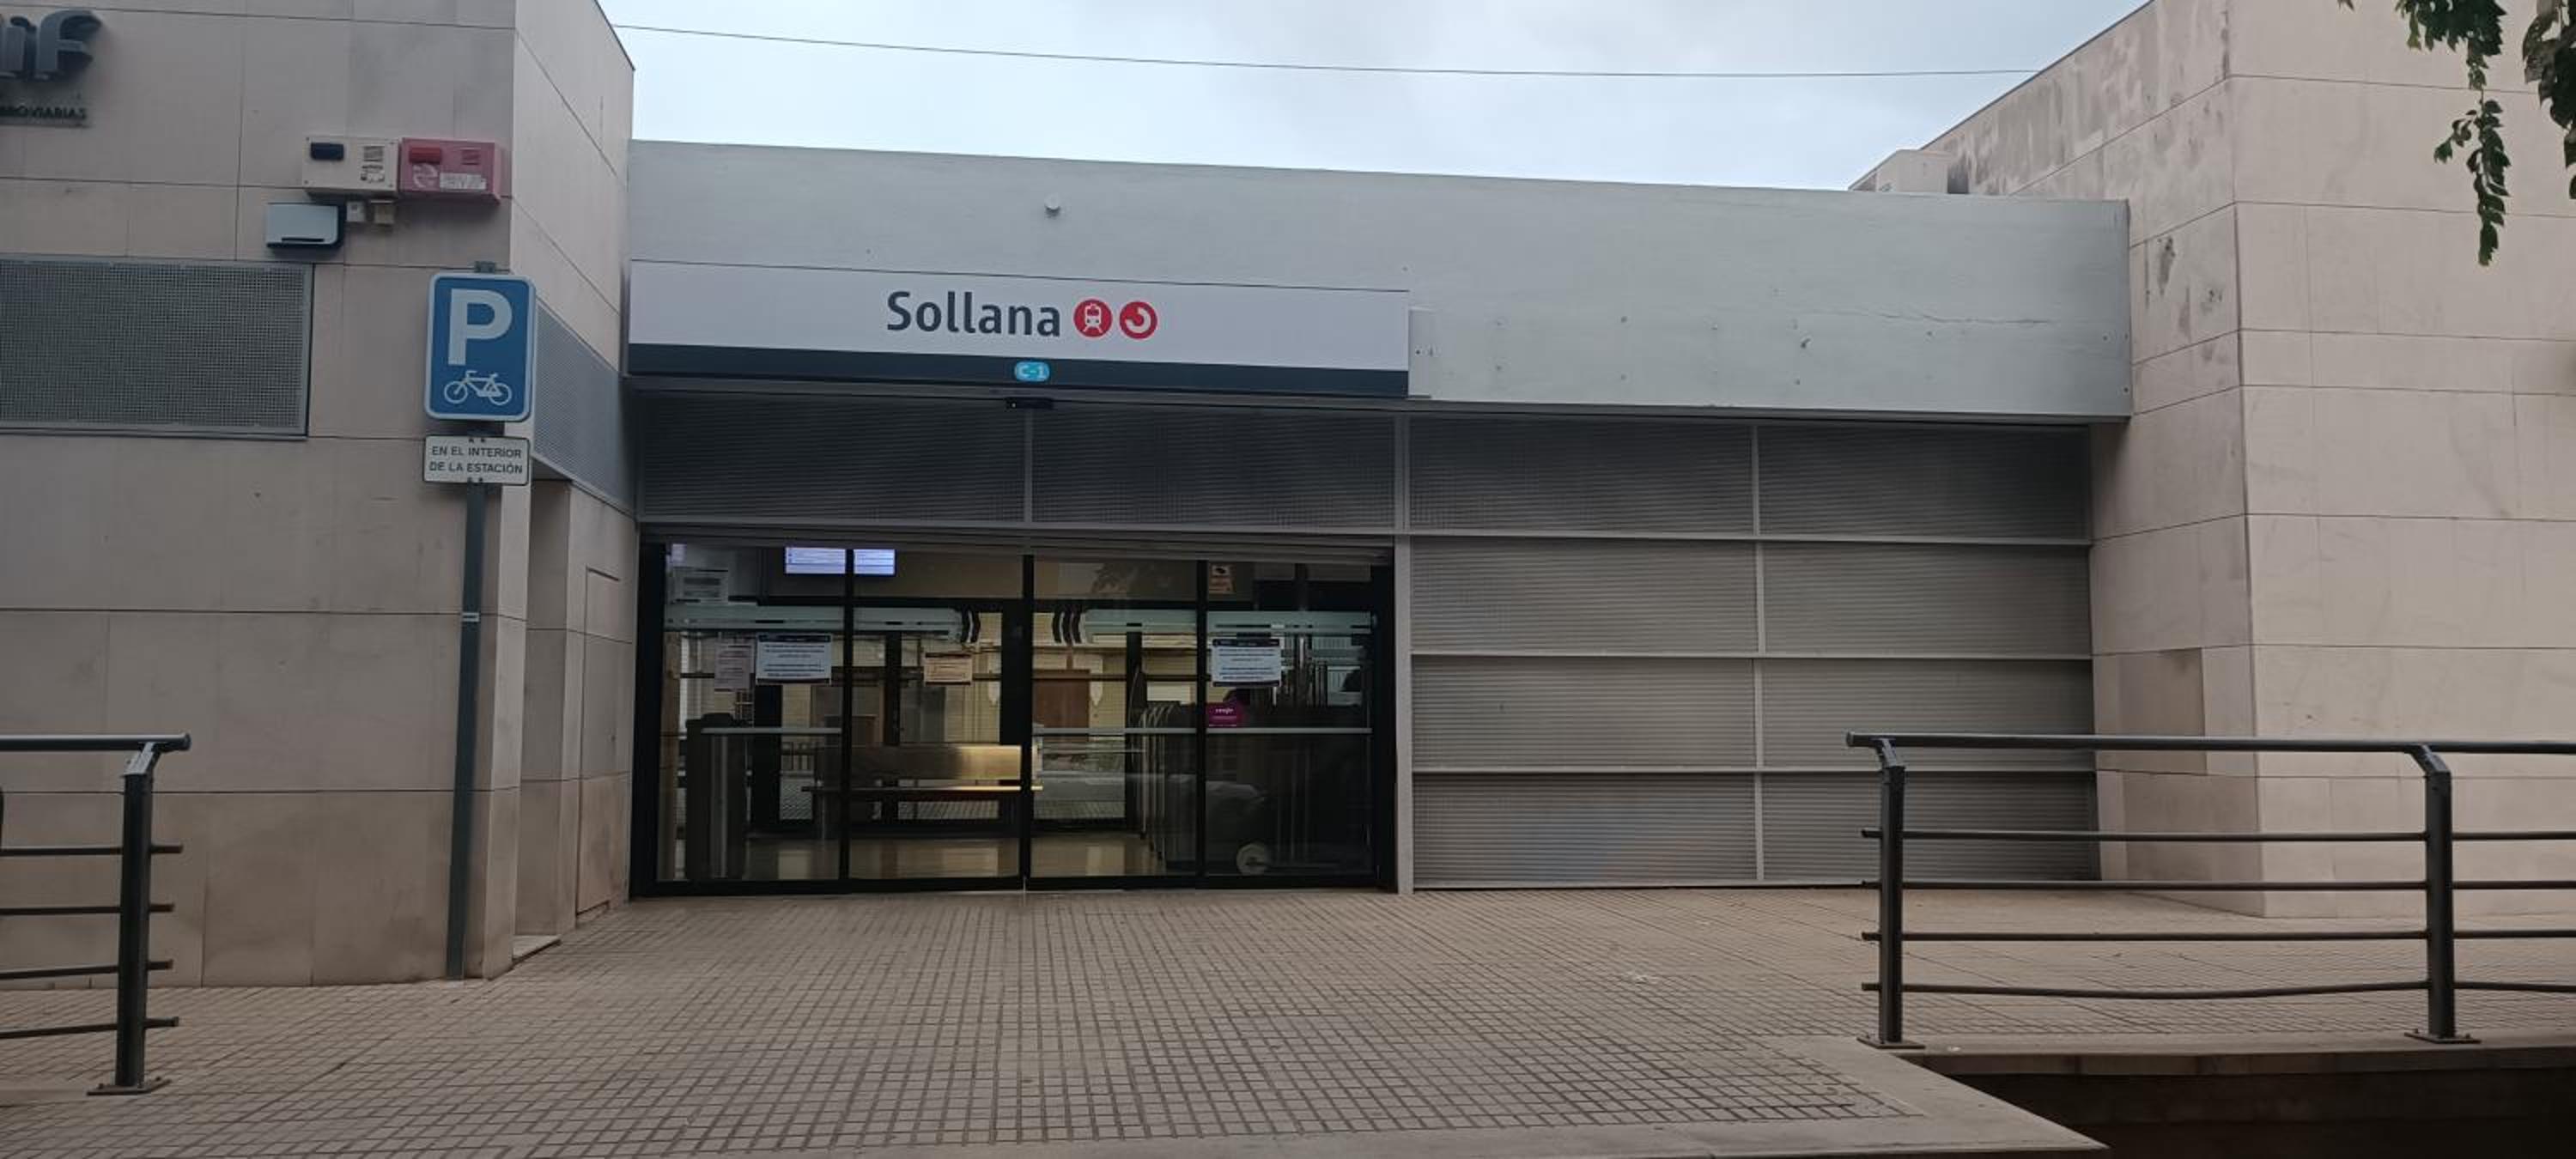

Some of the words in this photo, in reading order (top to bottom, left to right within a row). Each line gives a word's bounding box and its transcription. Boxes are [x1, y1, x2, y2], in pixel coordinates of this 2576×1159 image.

[886, 290, 1061, 337] Sollana
[447, 288, 513, 366] P
[1016, 363, 1046, 380] C-1
[431, 446, 447, 456] EN
[451, 446, 465, 457] EL
[468, 447, 522, 458] INTERIOR
[429, 461, 446, 471] DE
[448, 463, 464, 472] LA
[466, 459, 523, 474] ESTACIÓN
